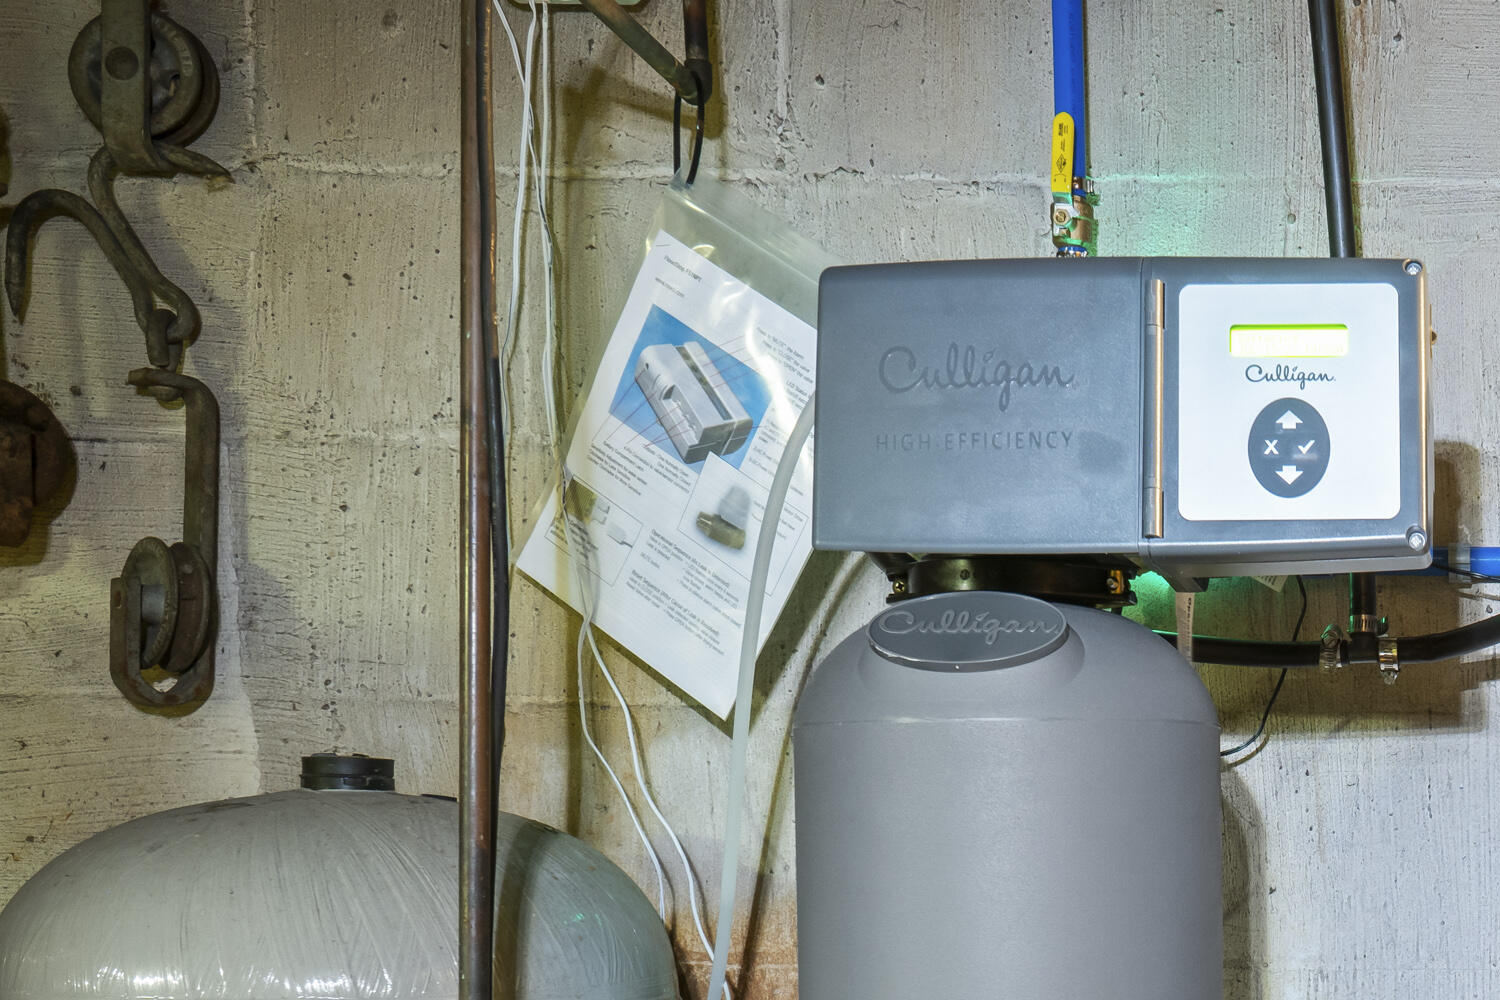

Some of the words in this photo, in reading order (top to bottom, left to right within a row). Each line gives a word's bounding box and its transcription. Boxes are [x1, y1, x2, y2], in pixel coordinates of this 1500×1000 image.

[877, 342, 1076, 413] Culligan
[1245, 364, 1334, 390] Culligan
[878, 611, 1059, 646] Culligan
